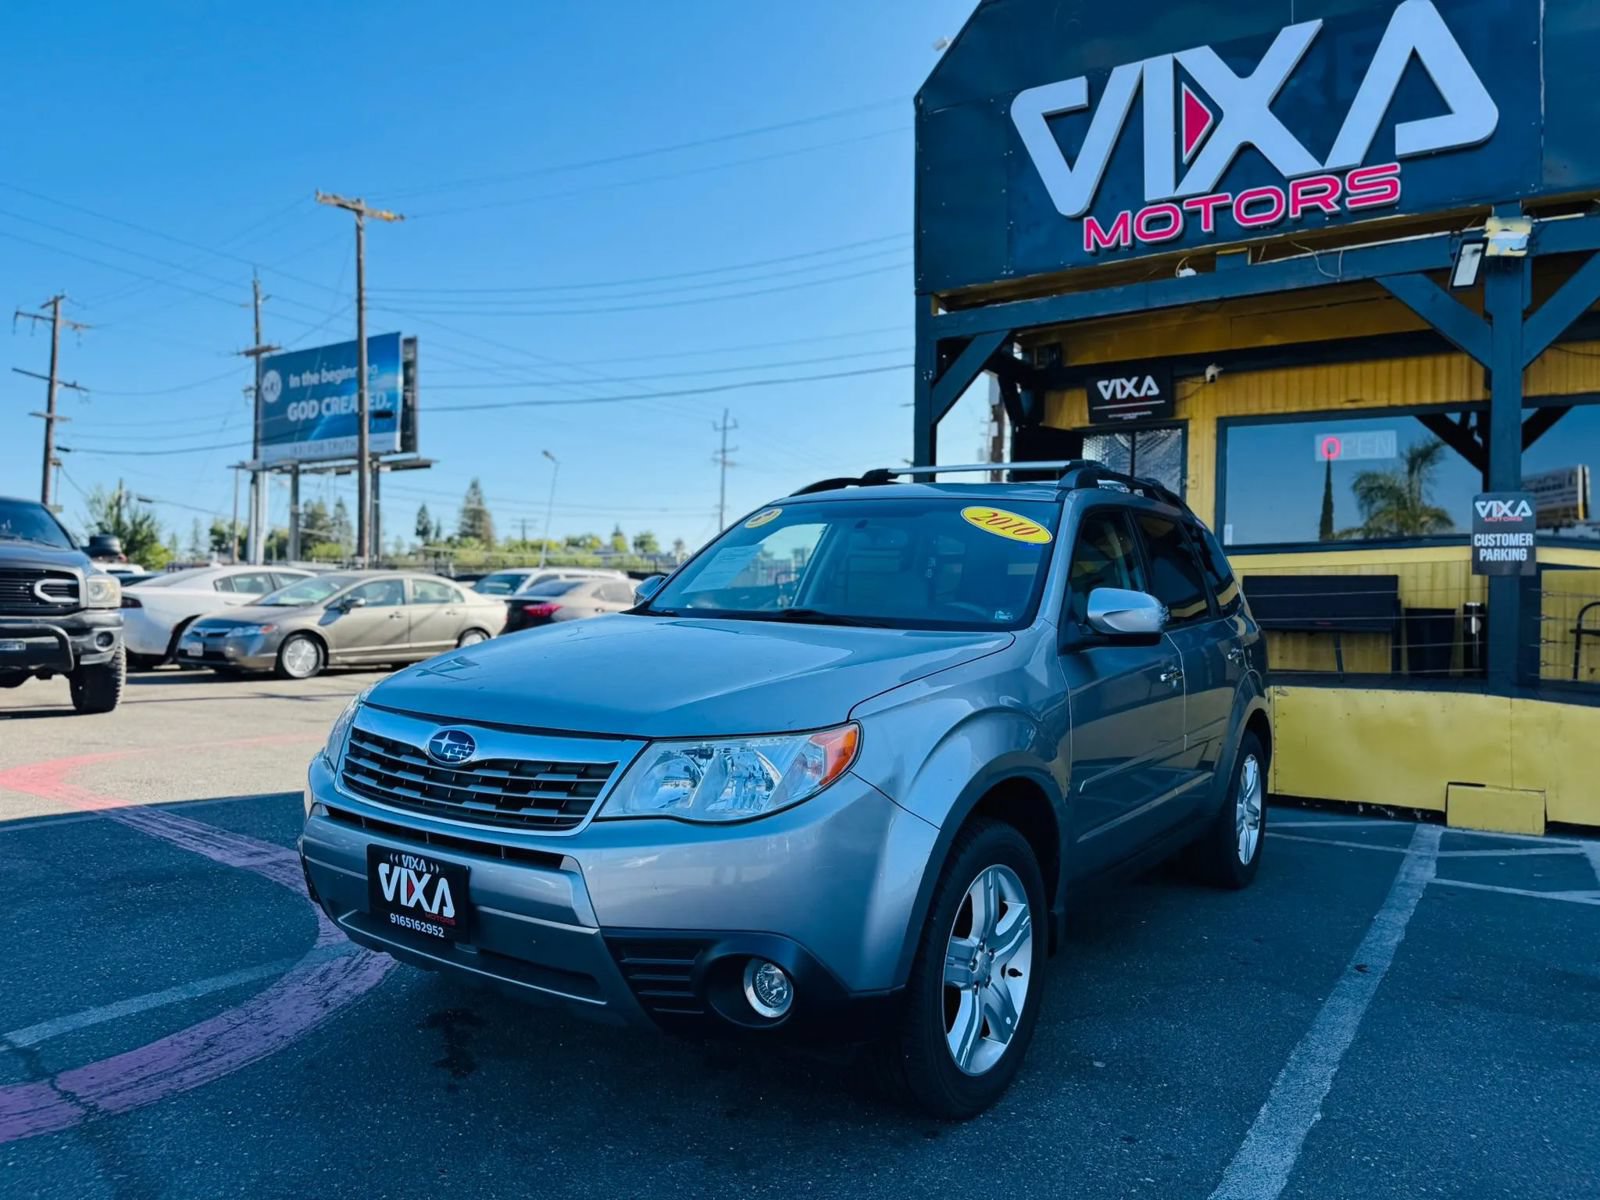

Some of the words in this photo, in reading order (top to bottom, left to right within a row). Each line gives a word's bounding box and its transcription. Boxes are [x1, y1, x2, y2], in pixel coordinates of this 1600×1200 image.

[1010, 0, 1499, 218] VIXA
[1083, 162, 1401, 253] MOTORS
[289, 374, 300, 388] In
[302, 370, 320, 385] the
[1097, 375, 1160, 400] VIXA
[287, 400, 319, 421] GOD
[1321, 432, 1396, 460] OPEN
[1475, 500, 1533, 518] VIXA
[970, 512, 1041, 536] 2010
[1474, 533, 1534, 547] CUSTOMER
[1480, 548, 1527, 562] PARKING
[401, 854, 427, 873] VIXA
[378, 862, 455, 918] VIXA
[389, 912, 445, 938] 9165162952
